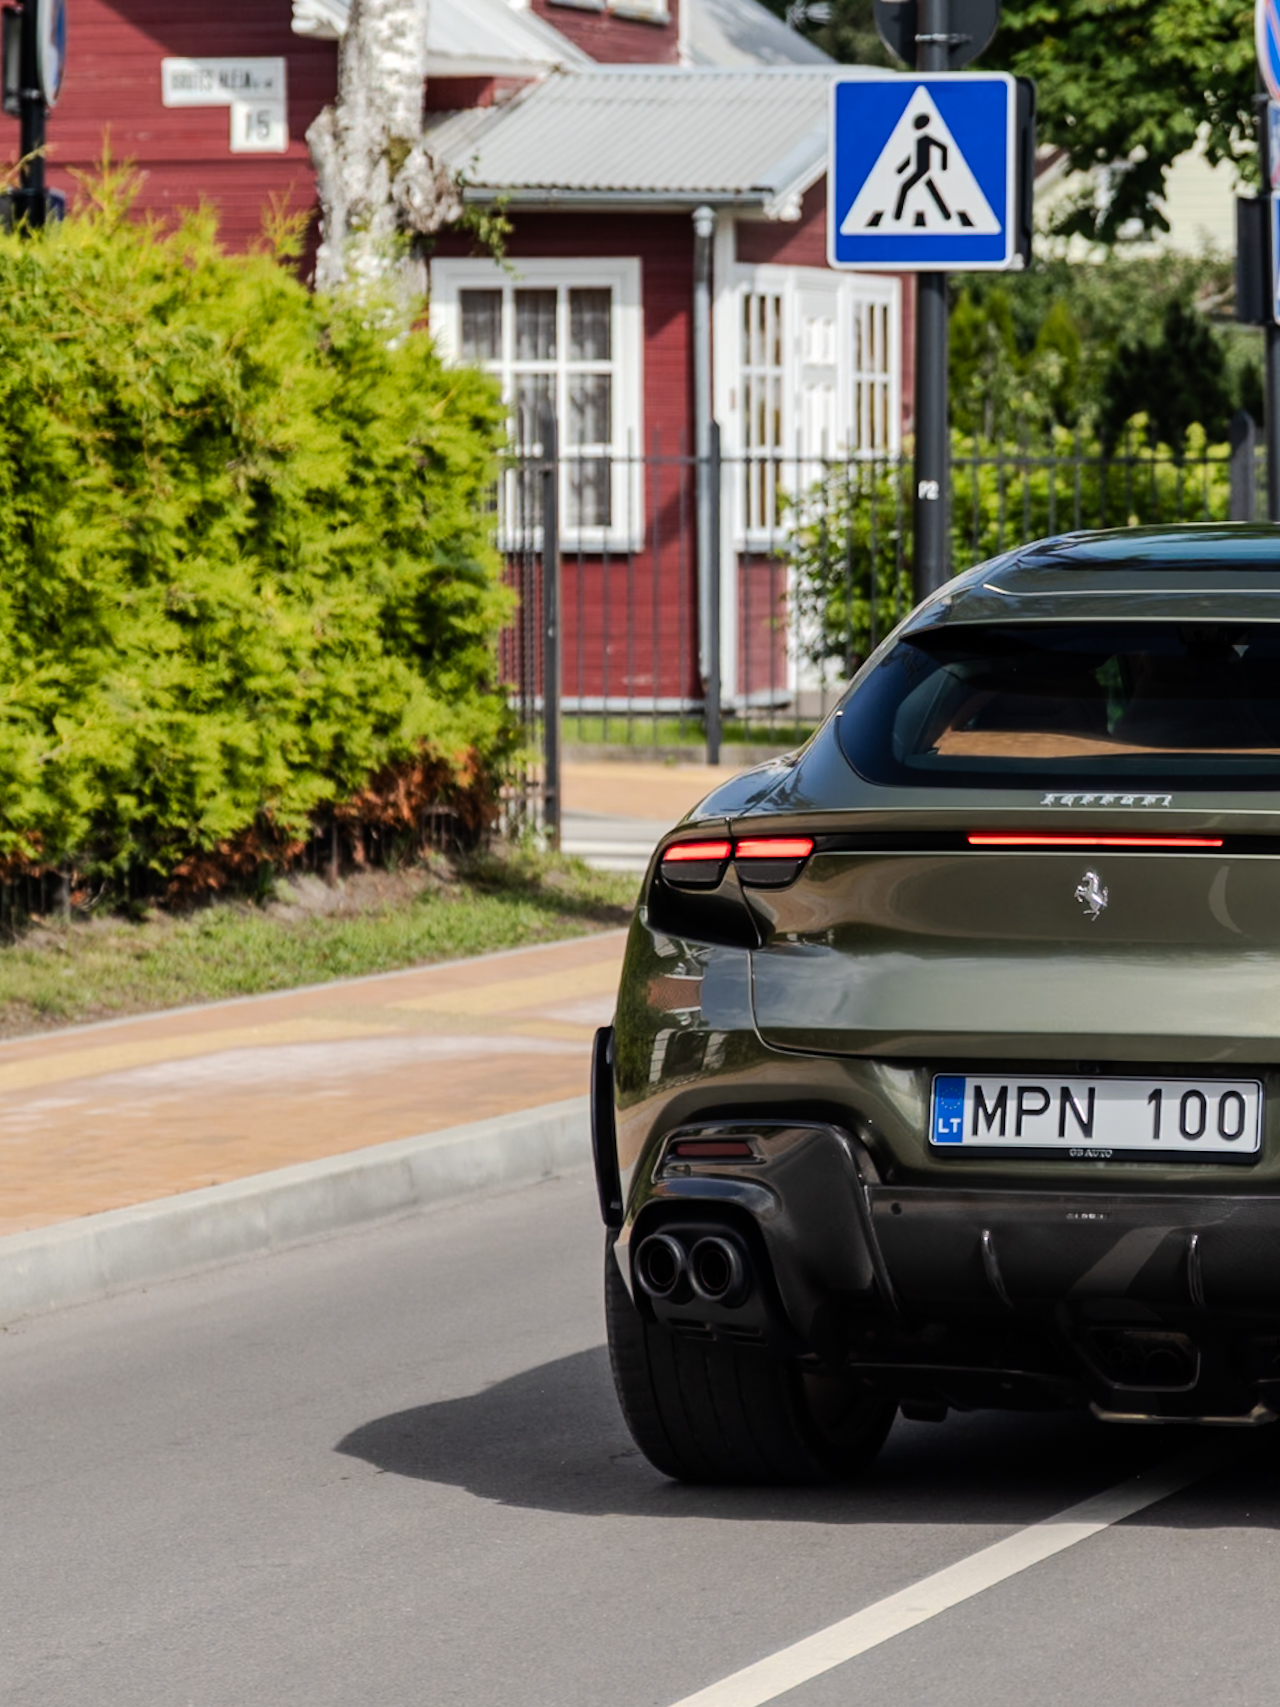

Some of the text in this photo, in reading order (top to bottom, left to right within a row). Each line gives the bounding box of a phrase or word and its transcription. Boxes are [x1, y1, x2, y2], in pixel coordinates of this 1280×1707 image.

[244, 109, 271, 141] 15
[971, 1084, 1246, 1141] MPN 100
[937, 1117, 962, 1134] LT
[1084, 1149, 1113, 1158] AUTO
